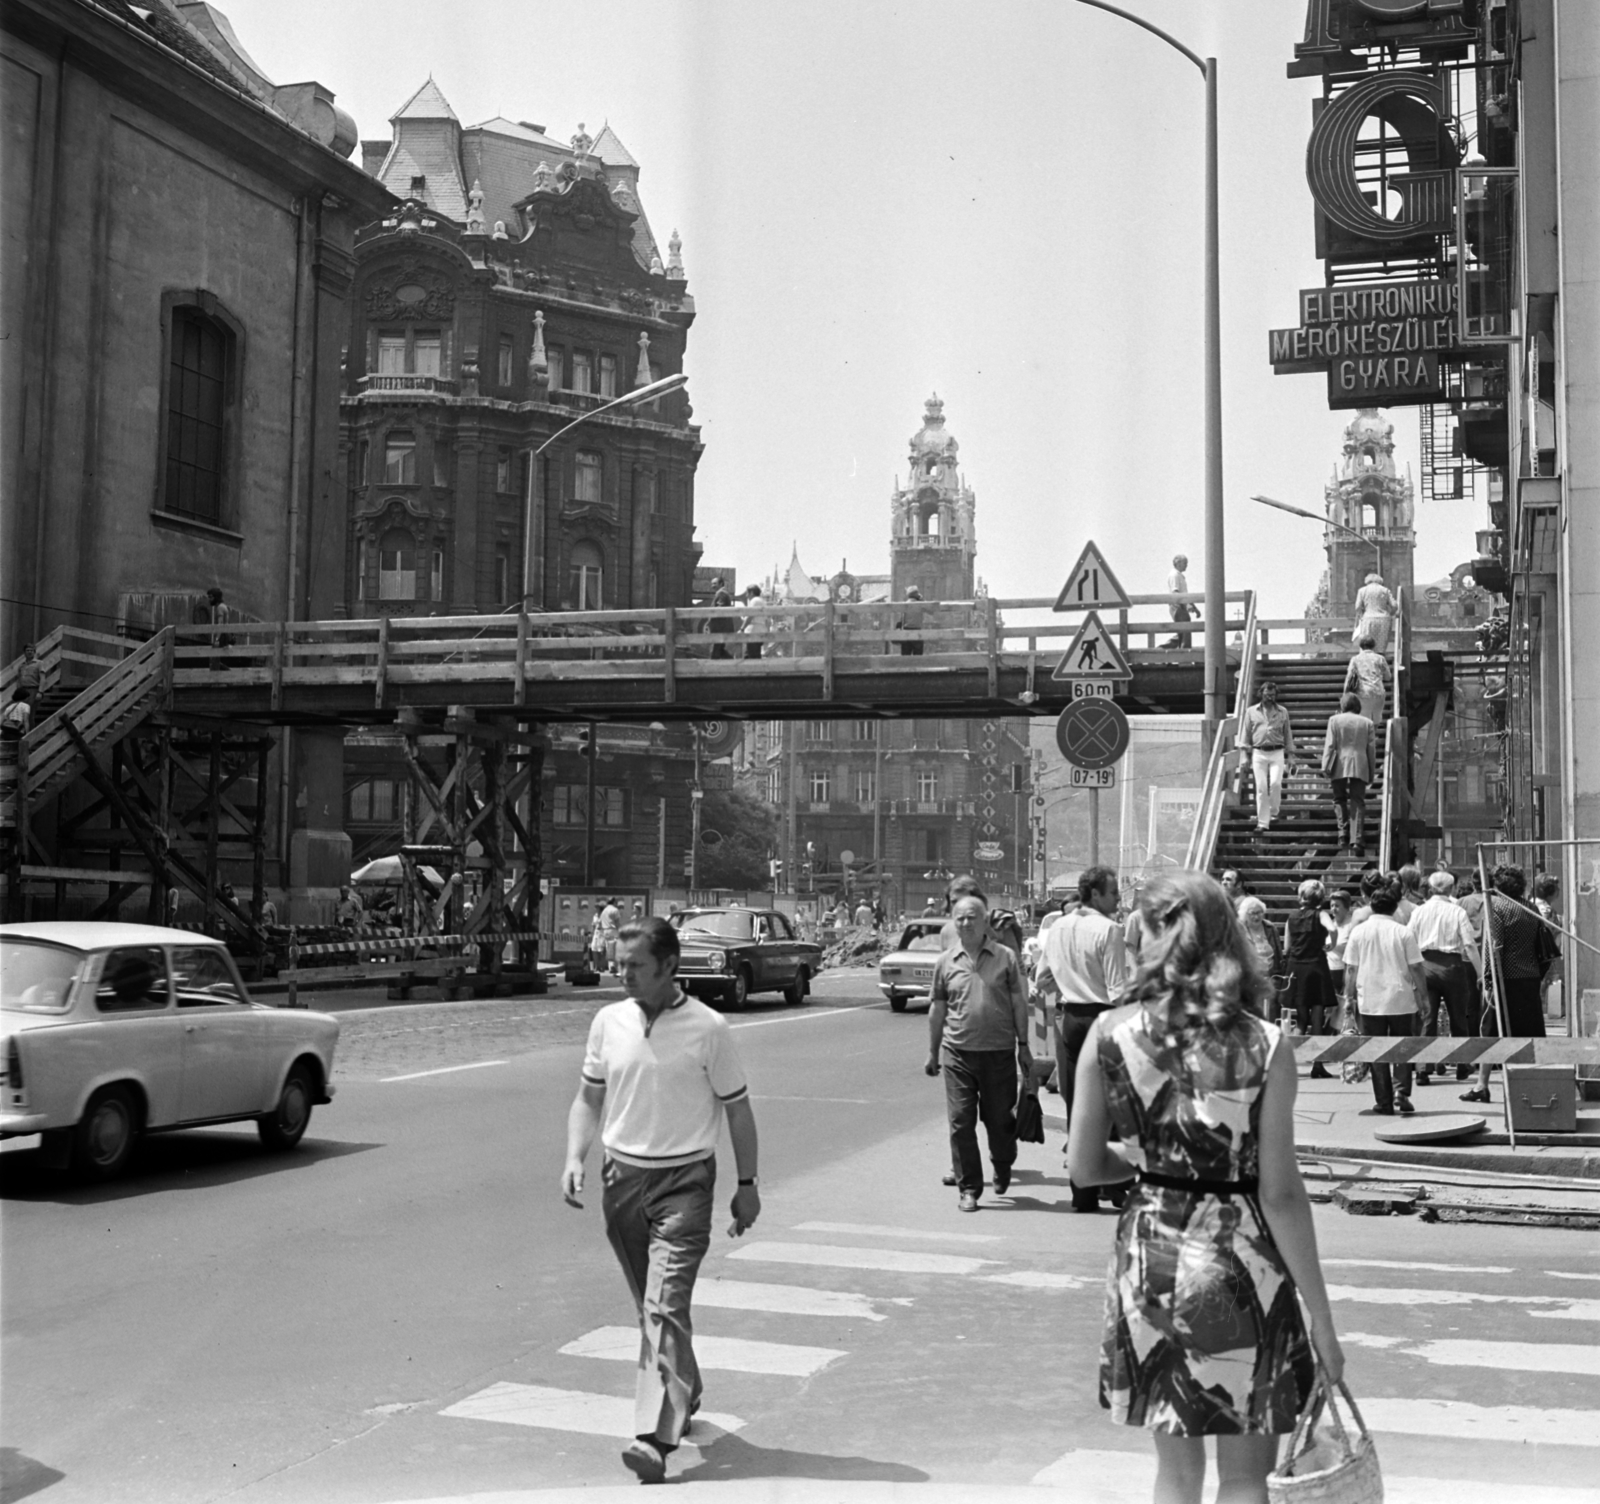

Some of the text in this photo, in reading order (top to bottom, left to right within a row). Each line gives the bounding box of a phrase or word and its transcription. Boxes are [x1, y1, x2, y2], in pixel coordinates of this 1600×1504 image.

[1340, 356, 1430, 390] GYÁRA
[1074, 683, 1111, 698] 60 m
